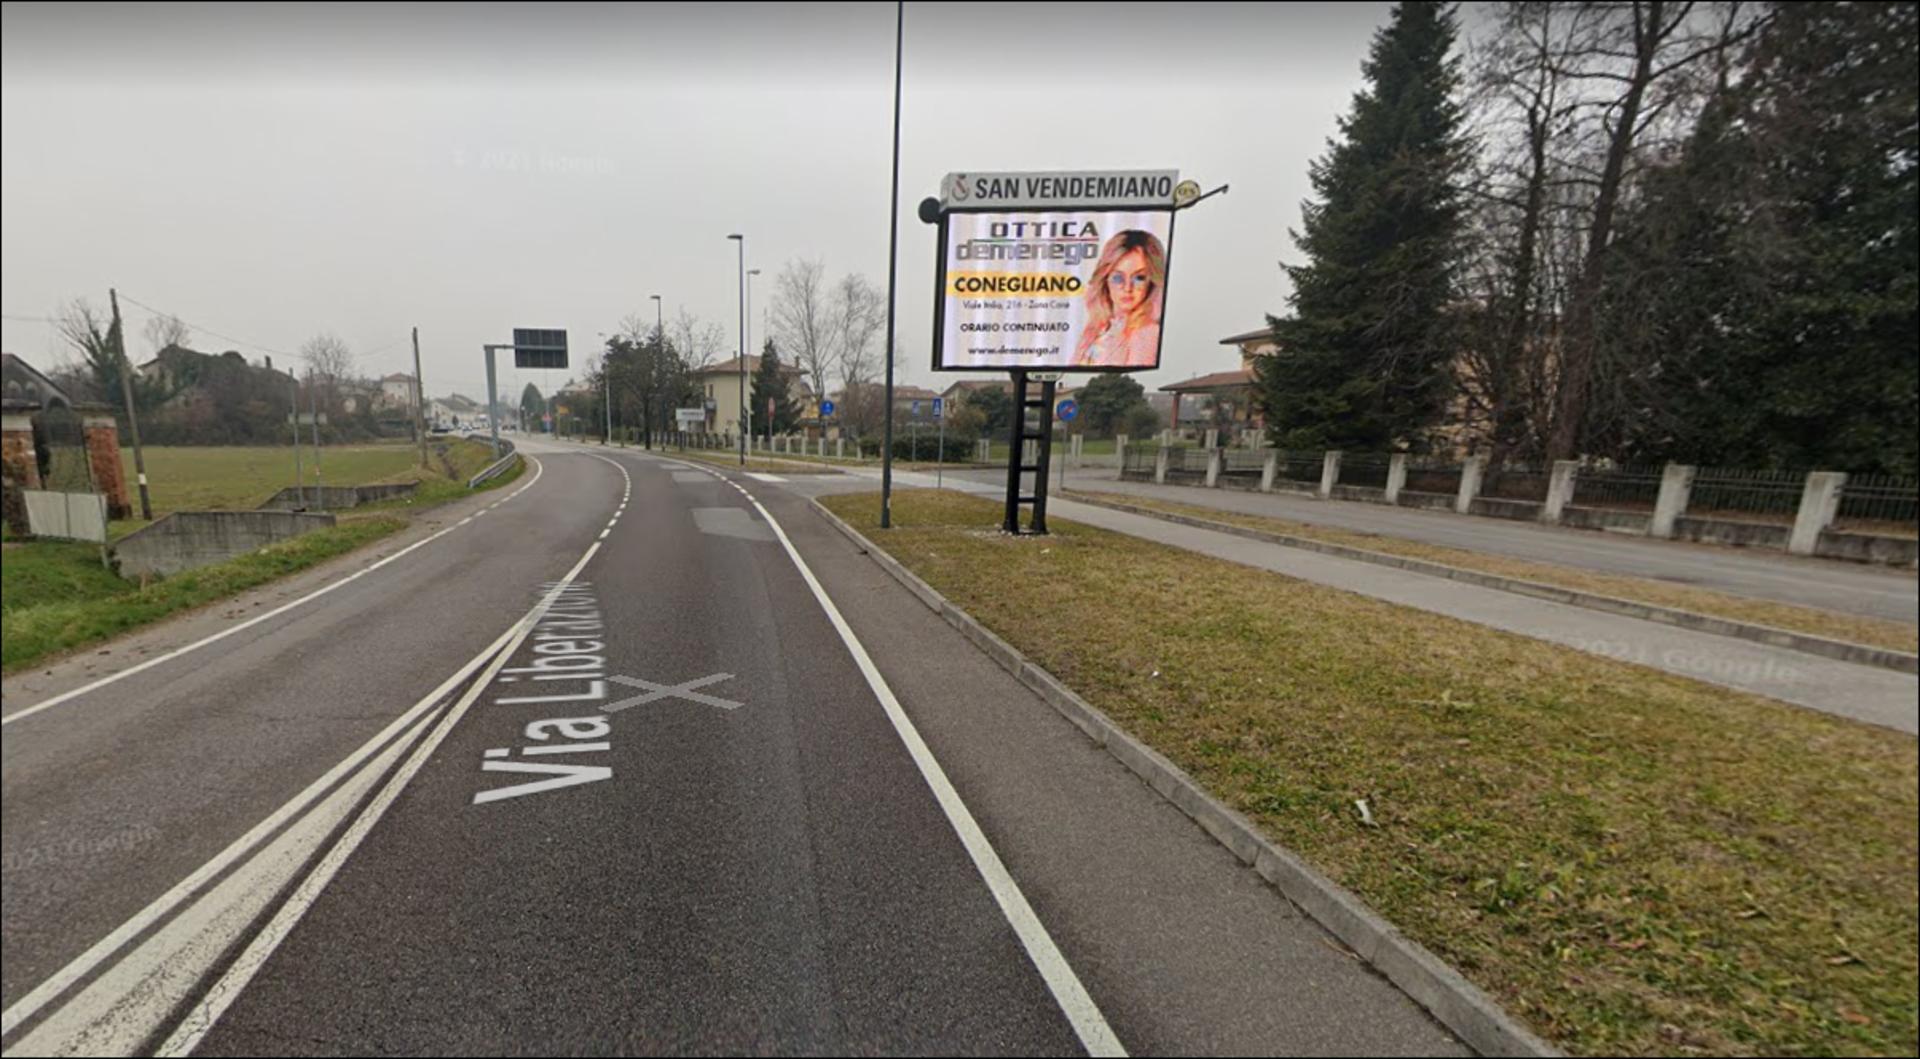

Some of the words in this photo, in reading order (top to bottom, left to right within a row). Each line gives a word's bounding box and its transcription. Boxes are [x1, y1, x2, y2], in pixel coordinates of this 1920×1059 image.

[975, 177, 1020, 199] SAN
[1026, 176, 1172, 199] VENDEMIANO
[990, 221, 1099, 238] OTTICA
[955, 239, 1099, 265] demenego
[954, 276, 1082, 292] CONEGLIANO
[960, 322, 1000, 332] ORARIO
[1002, 322, 1071, 332] CONTINUATO
